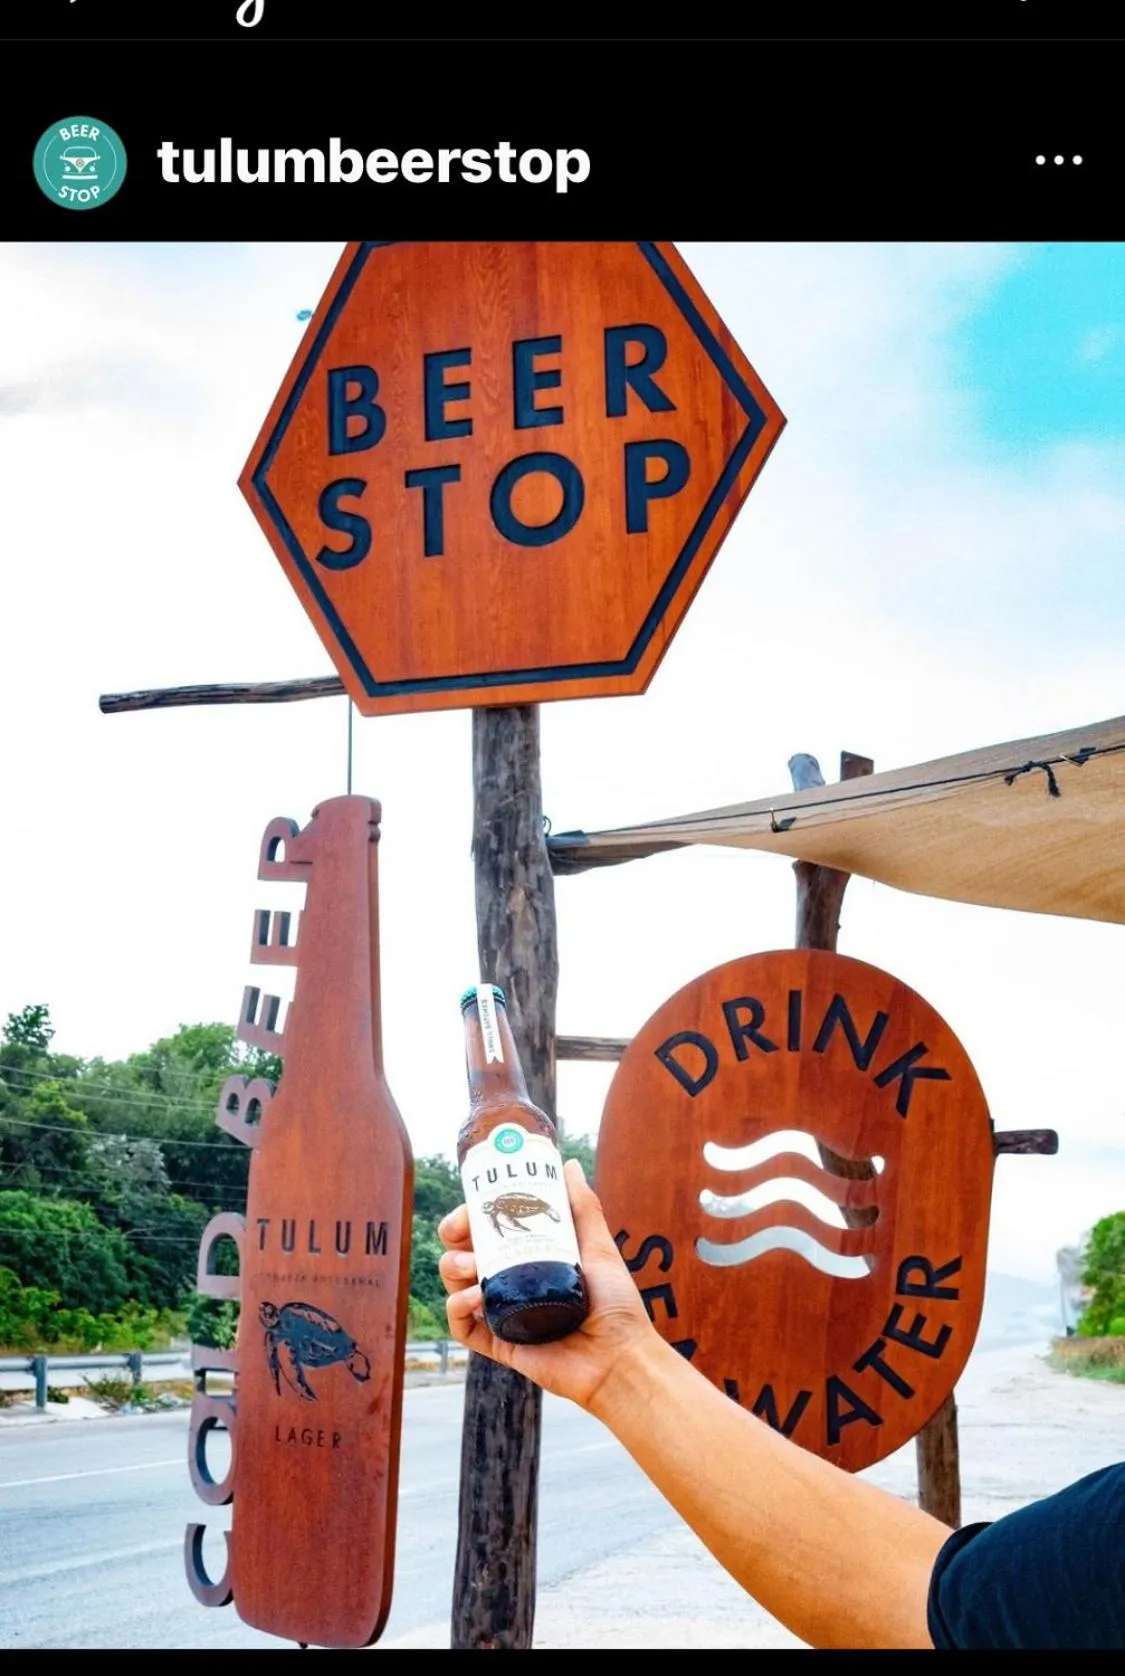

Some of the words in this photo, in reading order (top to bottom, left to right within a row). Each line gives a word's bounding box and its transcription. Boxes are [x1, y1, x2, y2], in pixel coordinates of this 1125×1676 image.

[327, 323, 677, 457] BEER
[315, 438, 691, 571] STOP
[654, 990, 953, 1119] DRINK
[184, 1212, 246, 1608] COLD
[215, 816, 313, 1150] BEER
[256, 1218, 390, 1256] TULUM
[471, 1161, 558, 1192] TULUM
[275, 1425, 342, 1449] LAGER
